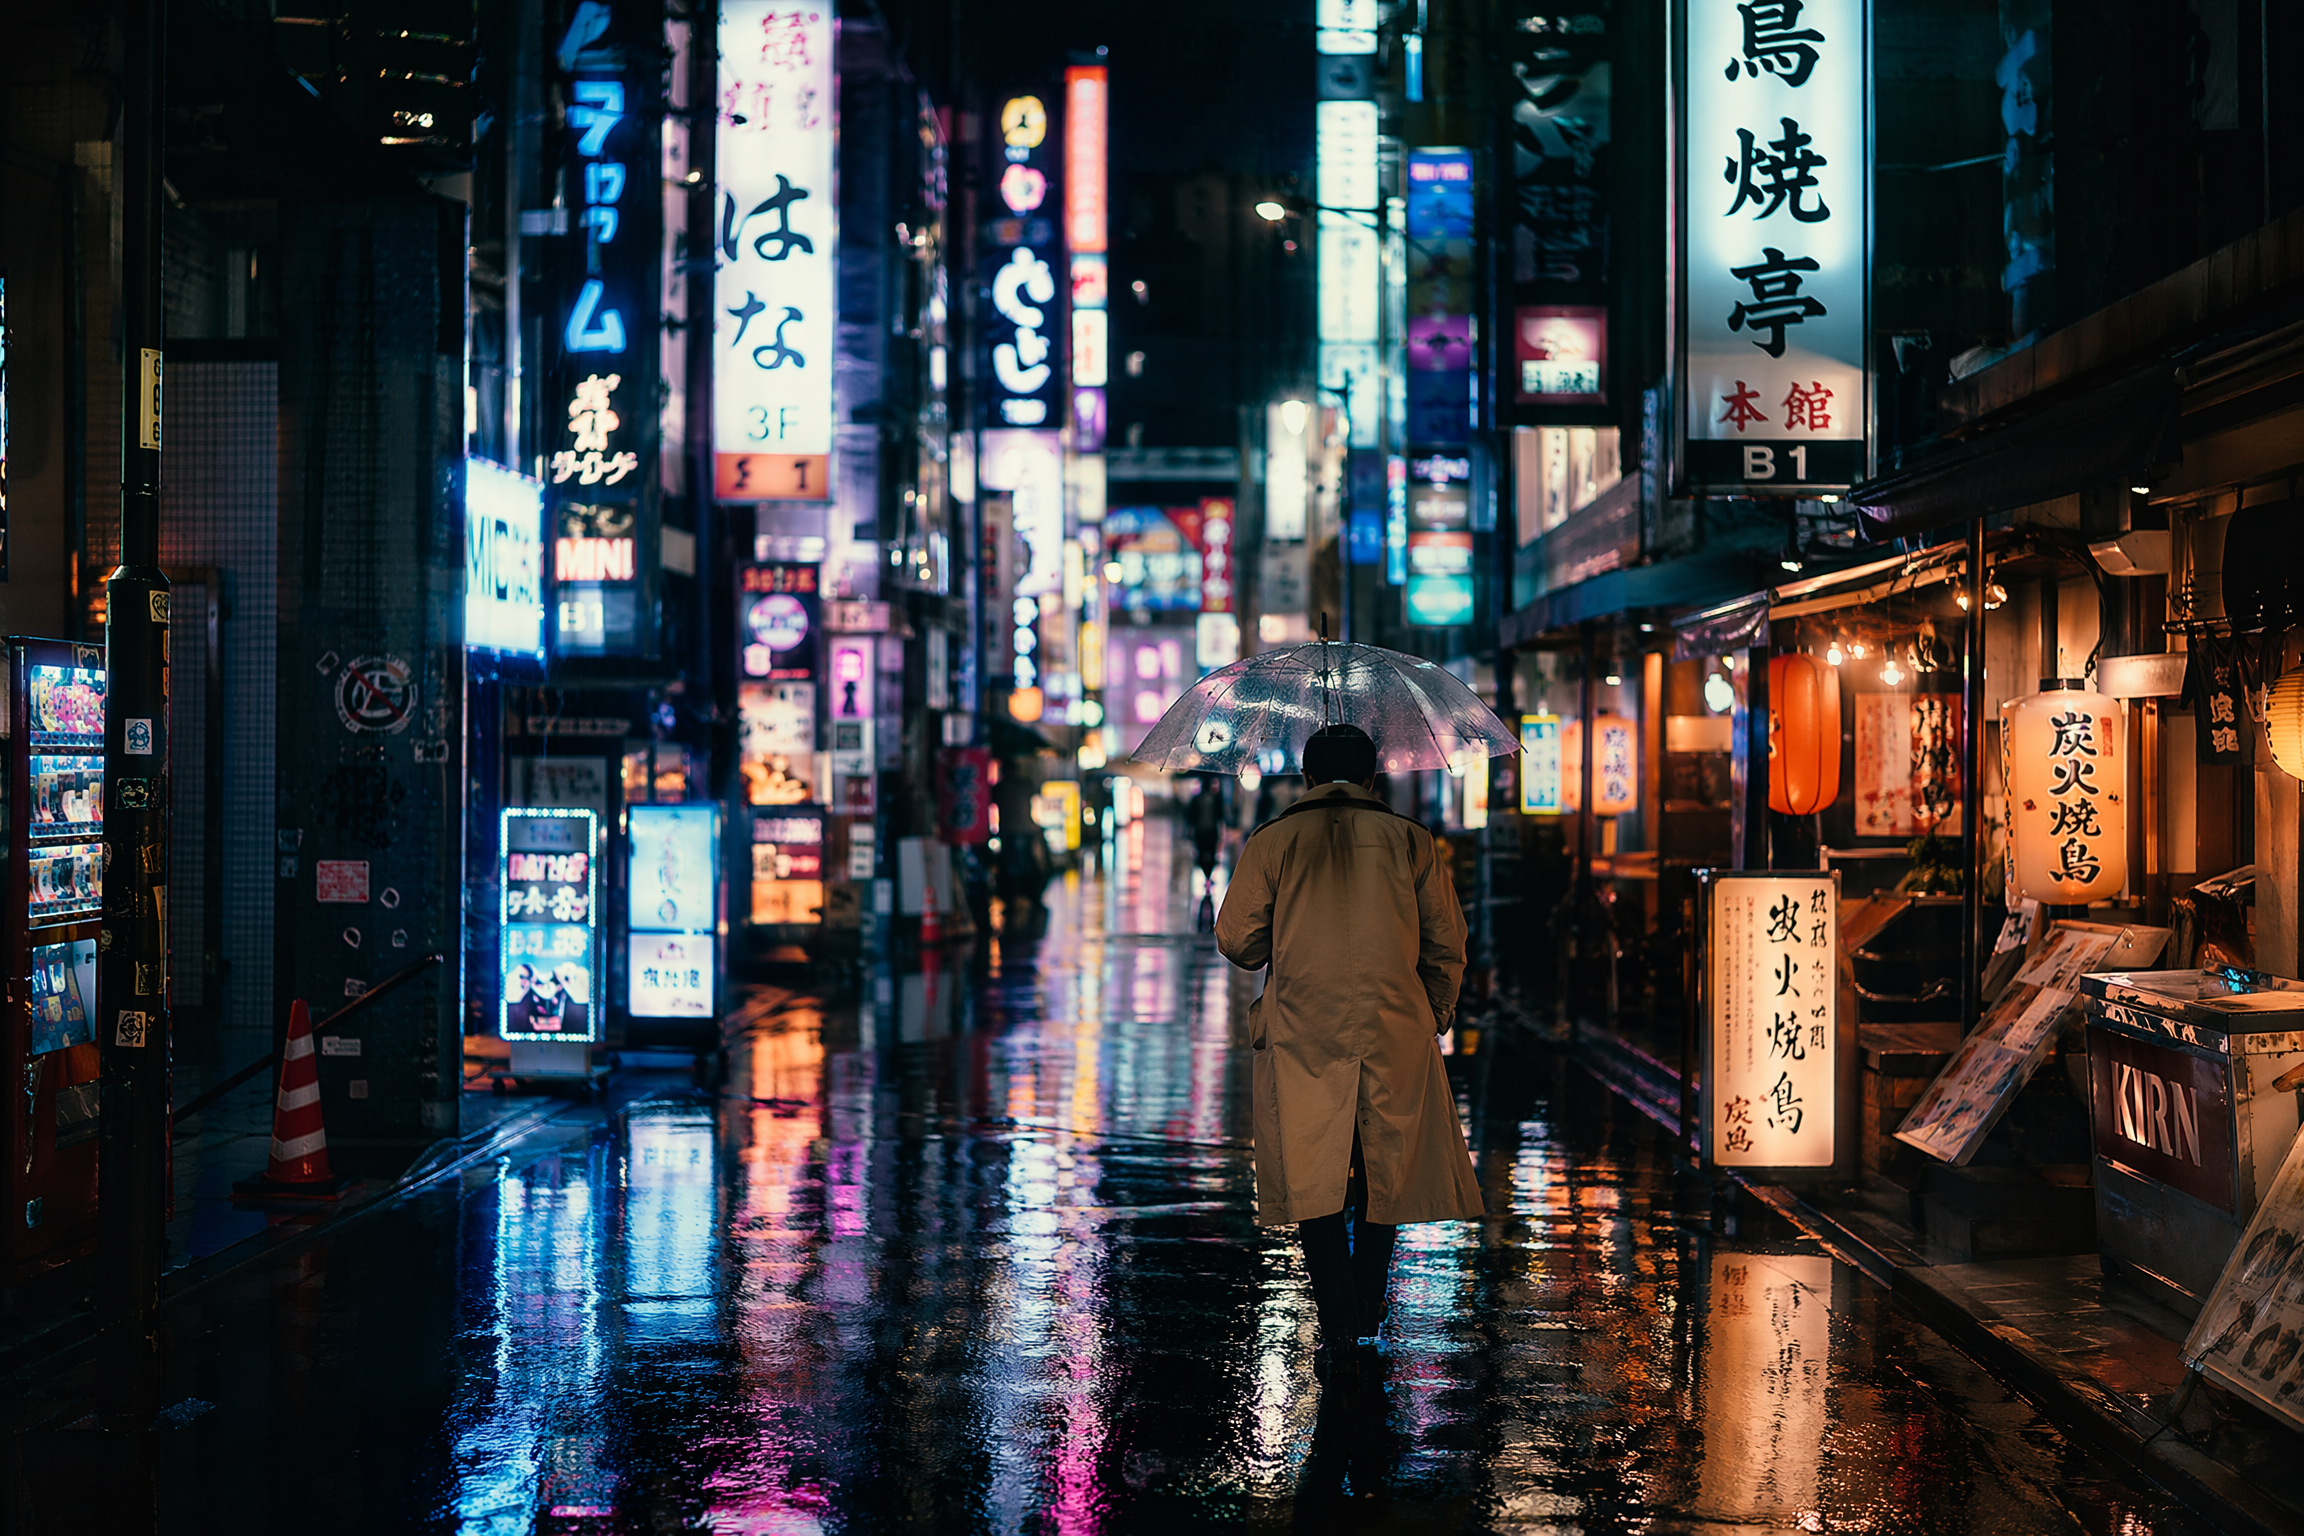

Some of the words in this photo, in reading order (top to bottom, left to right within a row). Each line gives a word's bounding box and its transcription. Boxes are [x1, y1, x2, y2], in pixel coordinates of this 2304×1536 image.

[748, 405, 800, 442] 3F
[1716, 380, 1836, 433] 本館
[1744, 445, 1808, 481] B1
[2048, 711, 2103, 884] 炭火焼鳥
[2110, 1060, 2202, 1167] KIRN
